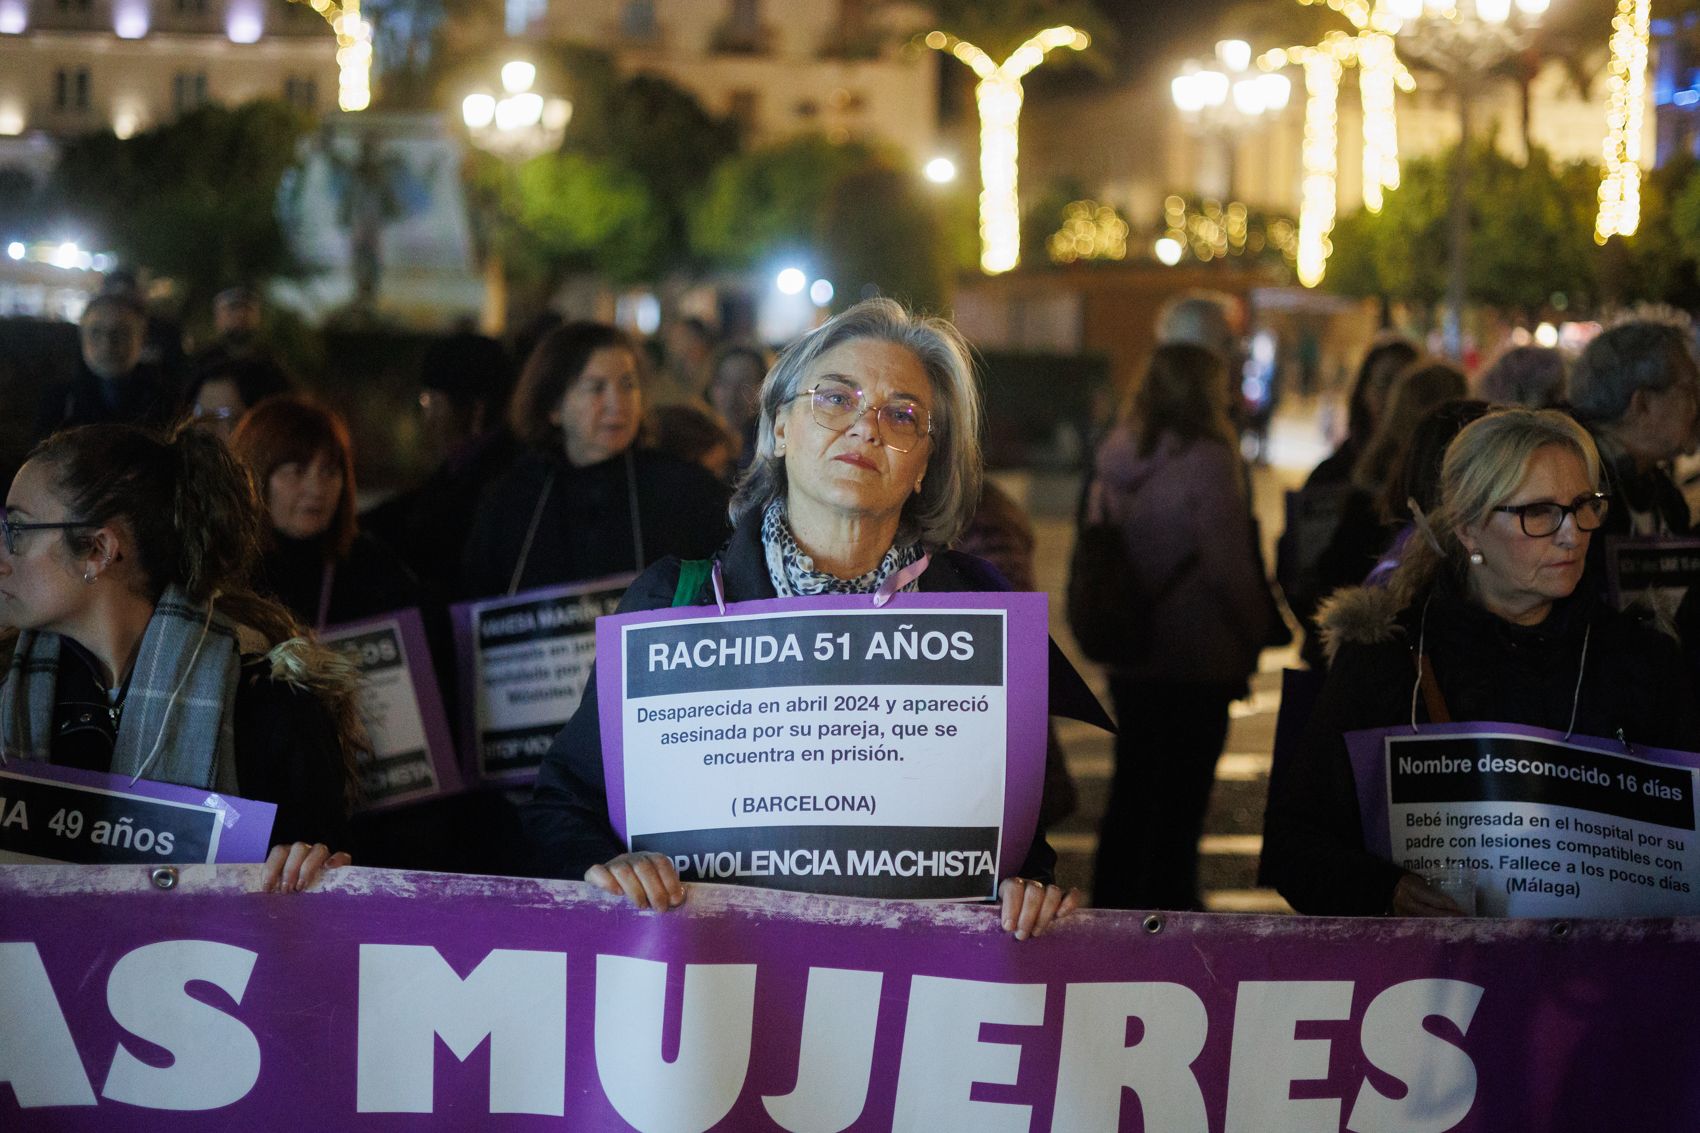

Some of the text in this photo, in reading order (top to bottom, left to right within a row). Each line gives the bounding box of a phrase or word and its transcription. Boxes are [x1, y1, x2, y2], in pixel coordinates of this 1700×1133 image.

[648, 624, 975, 672] RACHIDA 51 AÑOS
[636, 694, 989, 724] Desaparecida en abril 2024 y apareció
[660, 721, 958, 745] asesinada por su pareja, que se
[702, 744, 905, 766] encuentra en prisión.
[1399, 754, 1683, 801] Nombre desconocido 16 días
[48, 808, 84, 840] 49
[90, 816, 175, 856] años
[1406, 811, 1685, 851] Bebé ingresada en el hospital por su
[693, 849, 840, 879] VIOLENCIA
[846, 850, 995, 878] MACHISTA
[1406, 833, 1683, 872] padre con lesiones compatibles con
[1499, 855, 1561, 872] Fallece
[1566, 862, 1576, 874] a
[1581, 861, 1605, 878] los
[1609, 868, 1655, 888] pocos
[1658, 875, 1691, 893] días
[1506, 876, 1581, 899] (Málaga)
[357, 943, 1485, 1133] MUJERES
